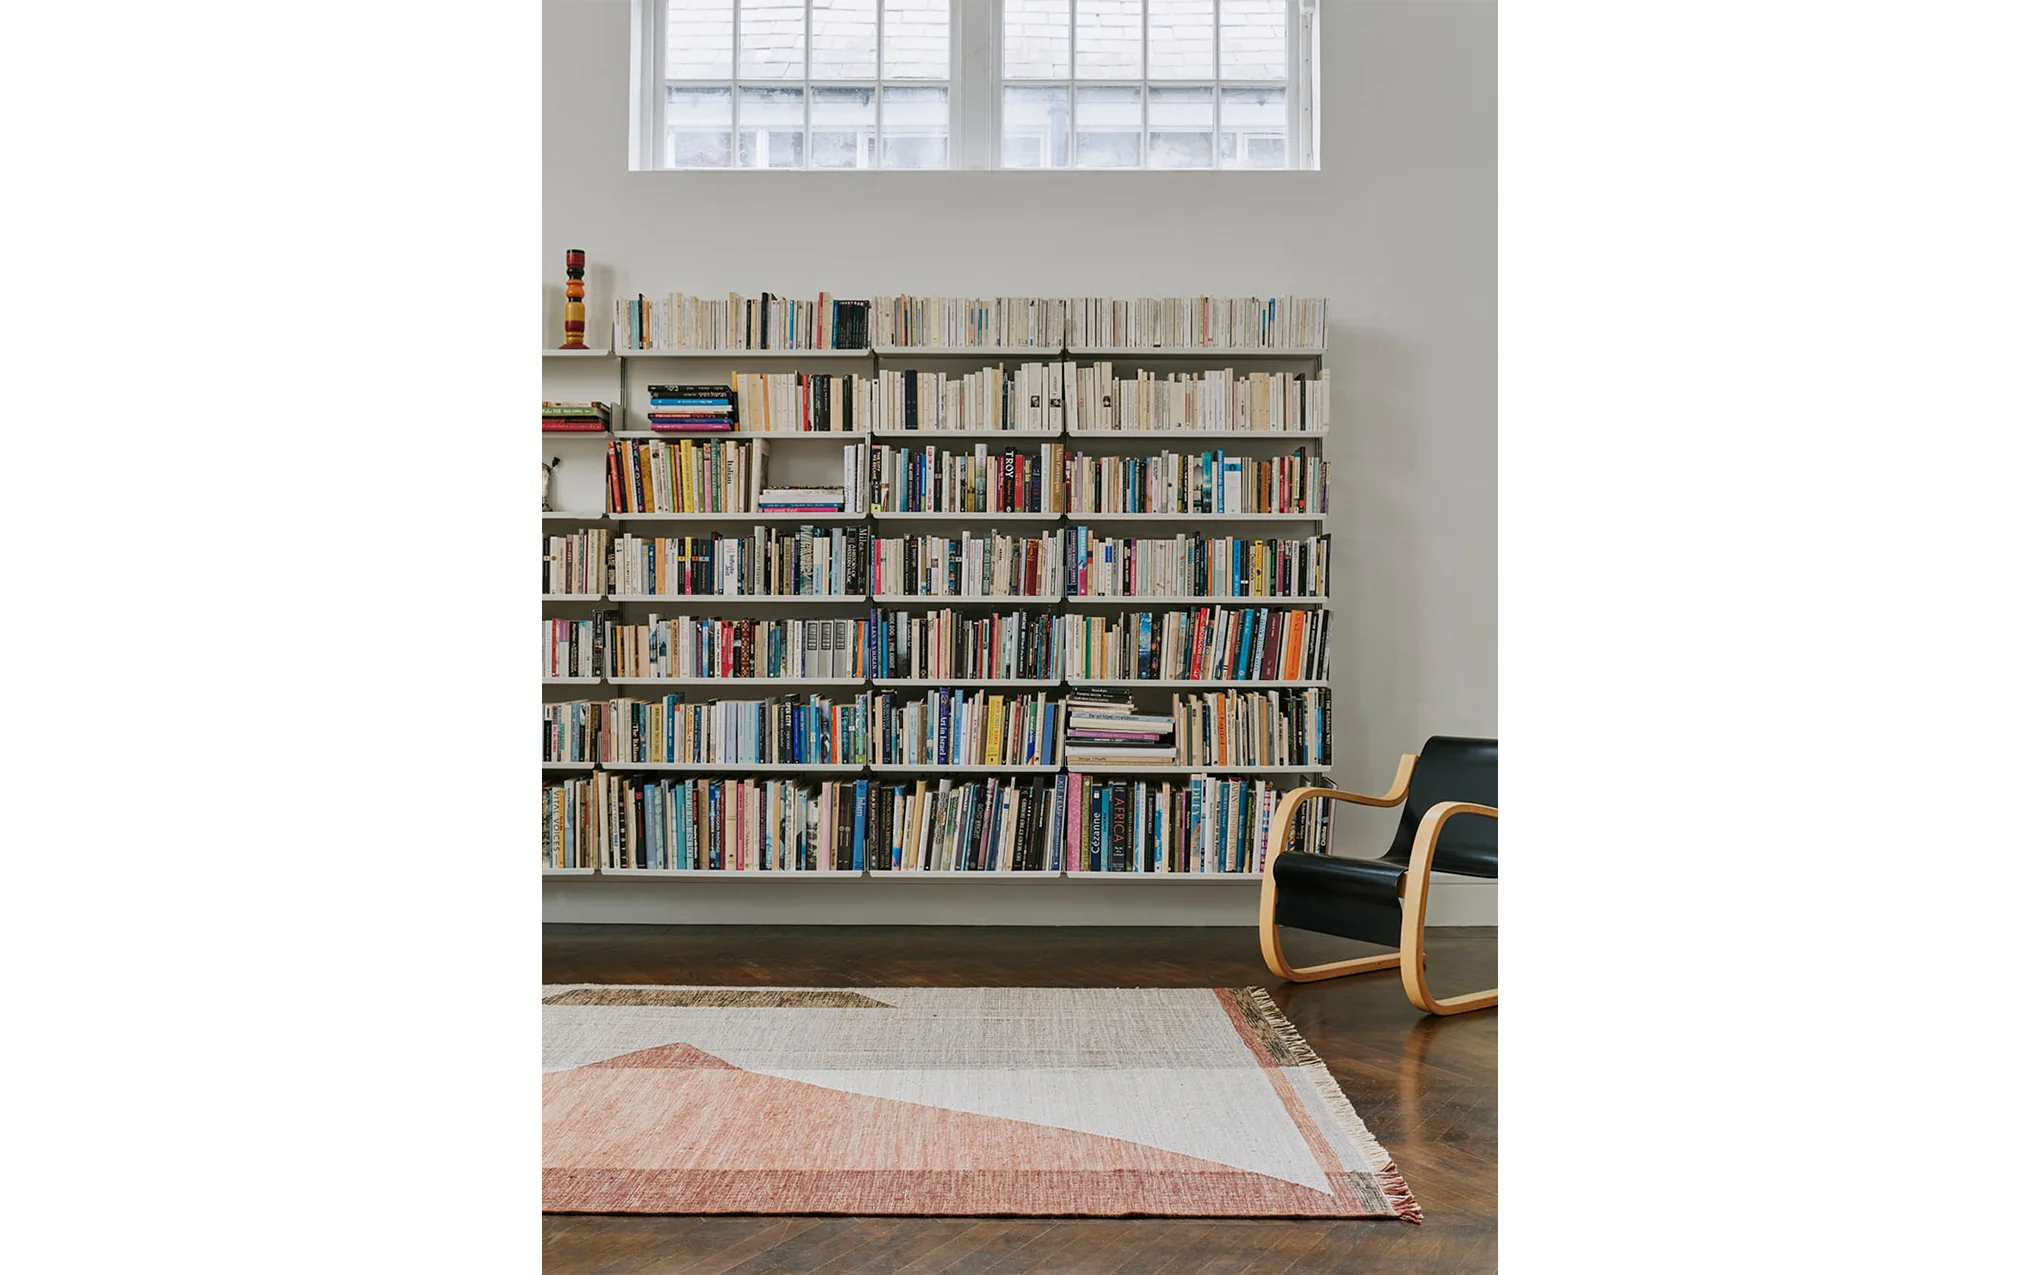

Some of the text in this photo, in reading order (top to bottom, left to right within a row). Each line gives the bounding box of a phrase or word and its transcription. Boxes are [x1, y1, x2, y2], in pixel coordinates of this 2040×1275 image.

[1005, 450, 1013, 478] TROY
[859, 528, 867, 550] Miles
[940, 727, 947, 735] in
[939, 735, 947, 756] Israel
[857, 797, 866, 817] Islam
[1192, 788, 1201, 818] DUFY
[1113, 797, 1125, 842] AFRICA
[1092, 812, 1101, 853] Cézanne
